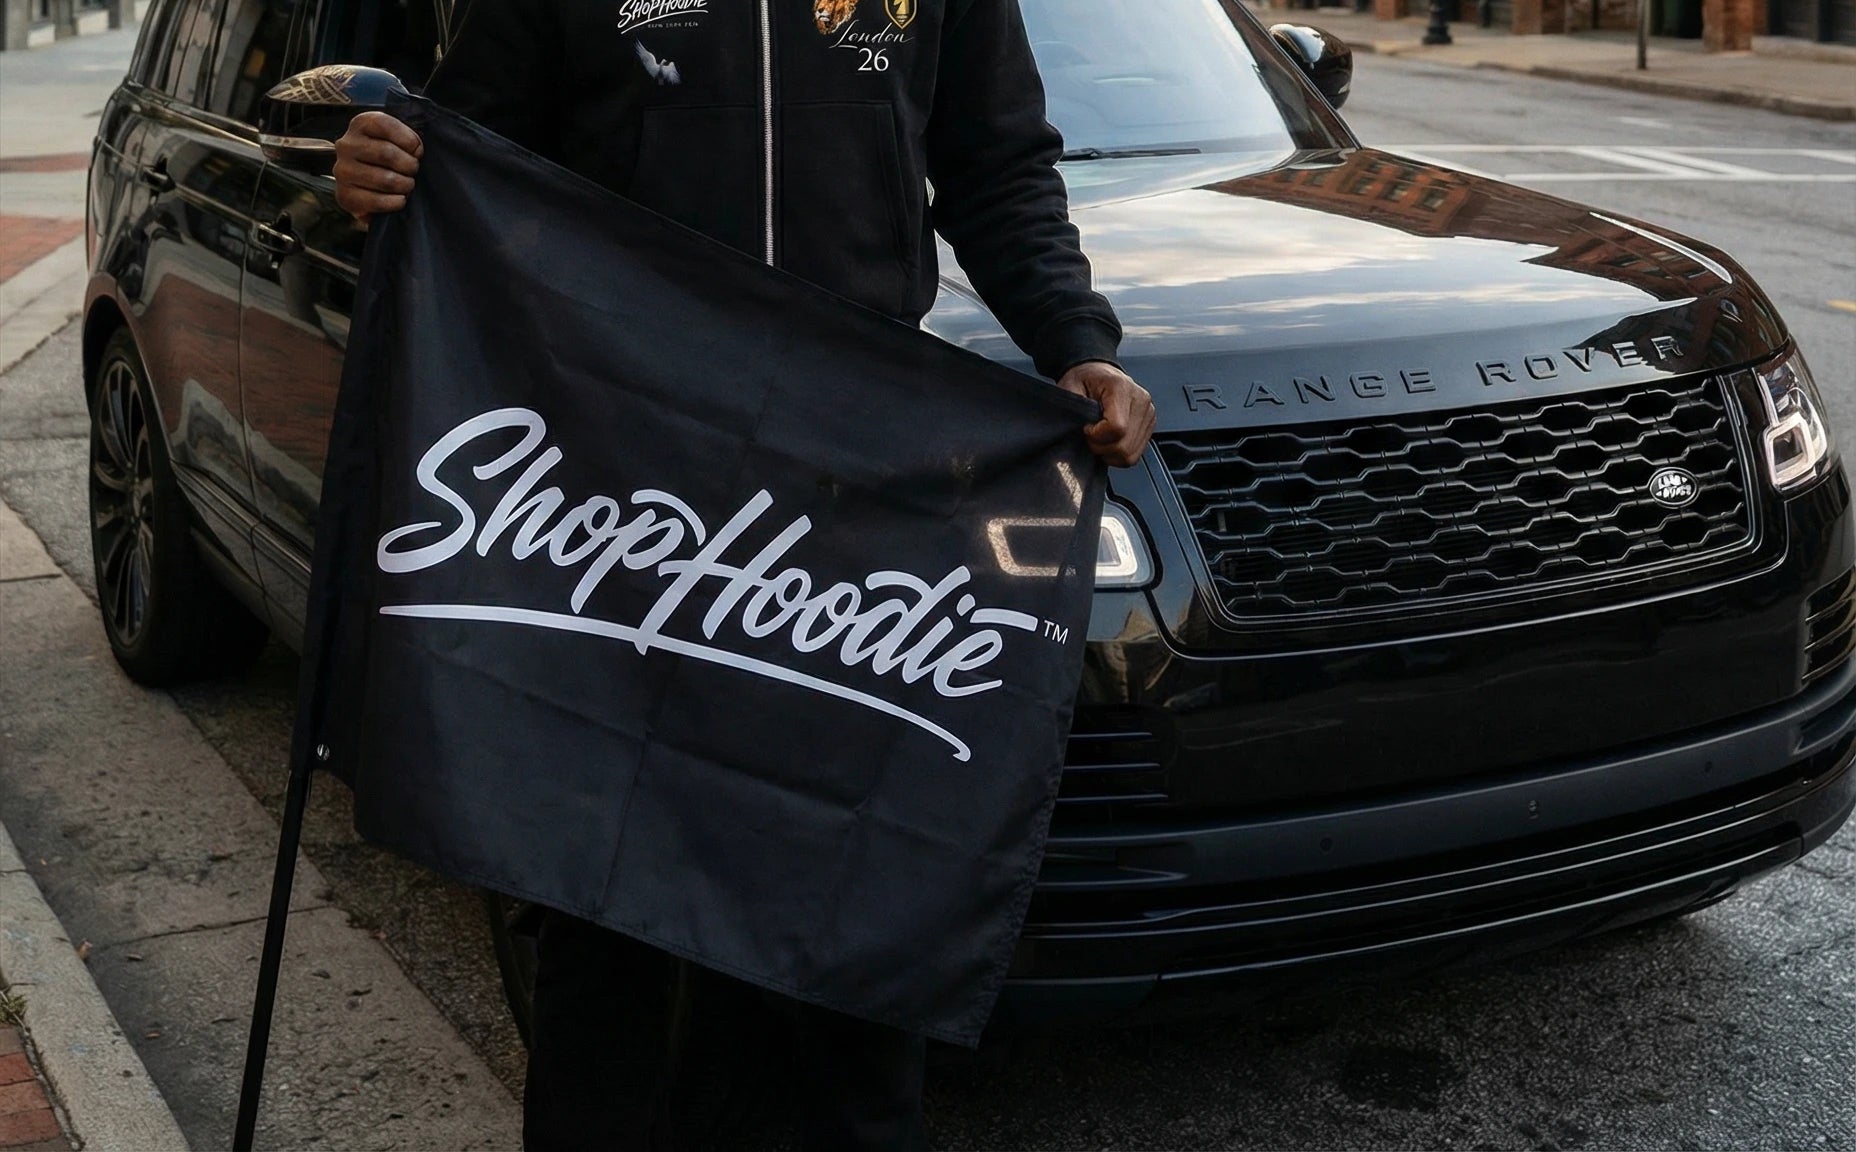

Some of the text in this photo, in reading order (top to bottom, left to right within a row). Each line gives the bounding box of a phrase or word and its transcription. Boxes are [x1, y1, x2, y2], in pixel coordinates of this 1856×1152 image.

[829, 19, 914, 49] London
[857, 48, 889, 72] 26
[1182, 335, 1685, 412] RANGE ROVER
[376, 407, 1039, 698] ShopHoodie
